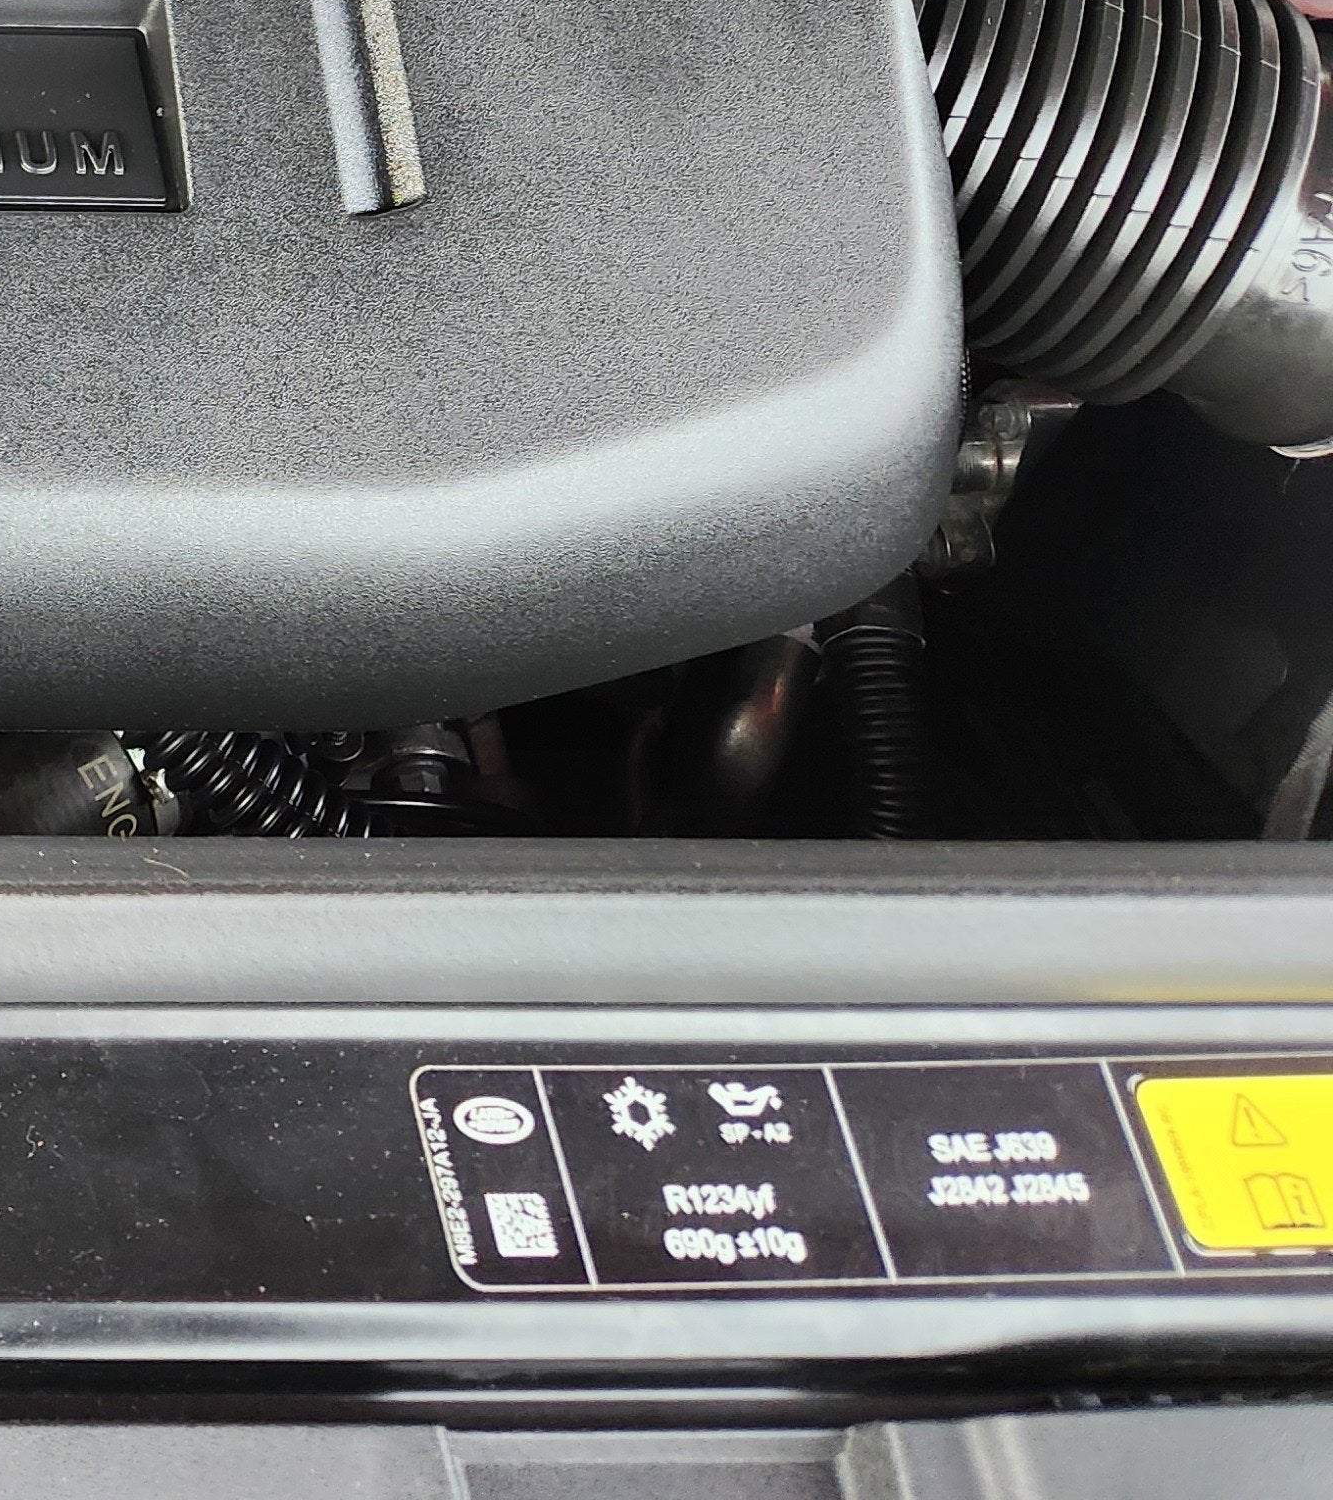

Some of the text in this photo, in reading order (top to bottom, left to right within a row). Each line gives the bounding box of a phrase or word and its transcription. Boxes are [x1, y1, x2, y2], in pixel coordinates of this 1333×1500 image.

[927, 1130, 1057, 1163] SAE J639
[661, 1183, 777, 1221] R1234yf
[926, 1172, 1091, 1206] J2842 J2845
[663, 1227, 737, 1266] 690g
